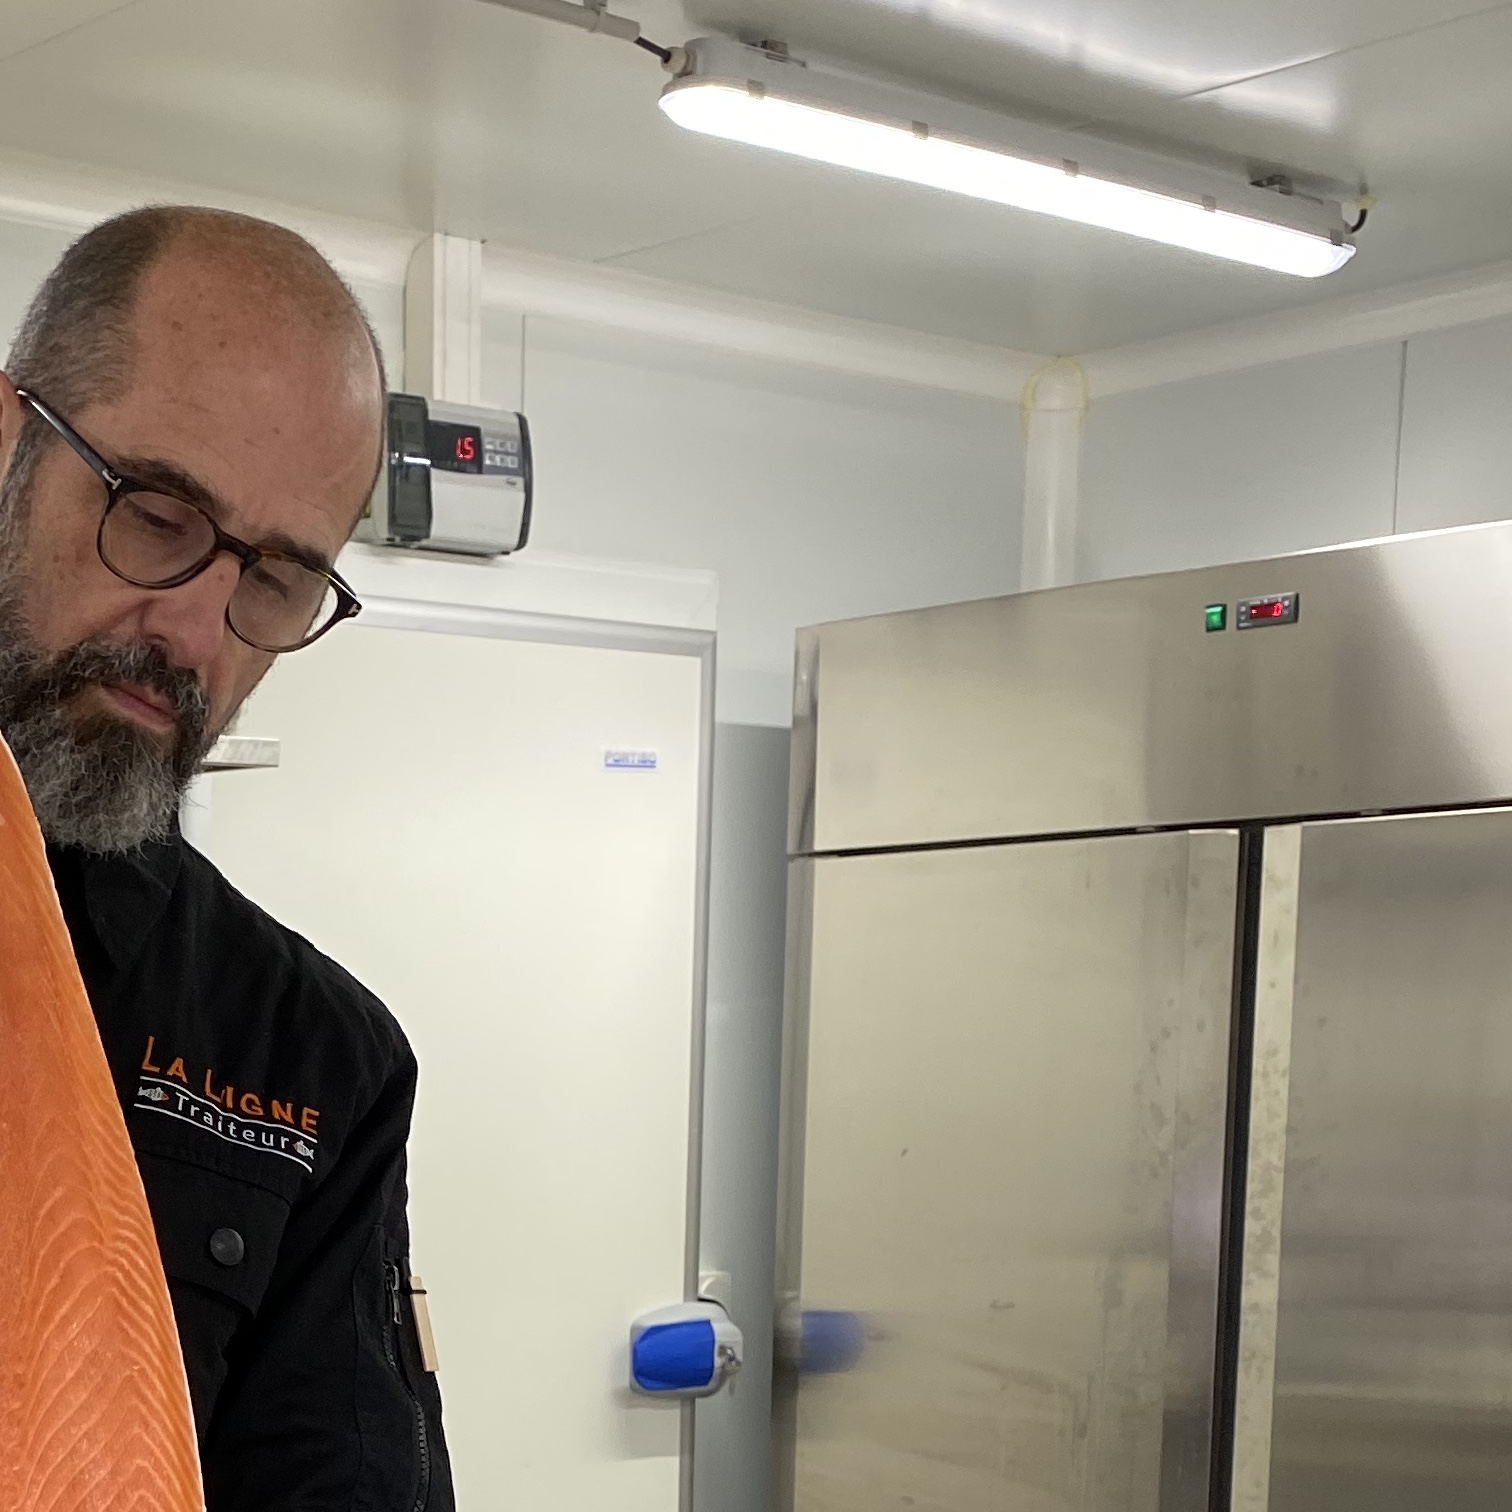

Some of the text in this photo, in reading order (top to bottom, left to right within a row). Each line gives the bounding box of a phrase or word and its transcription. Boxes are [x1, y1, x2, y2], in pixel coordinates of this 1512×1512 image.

[141, 1035, 320, 1135] LA LIGNE
[175, 1091, 290, 1149] Traiteur
